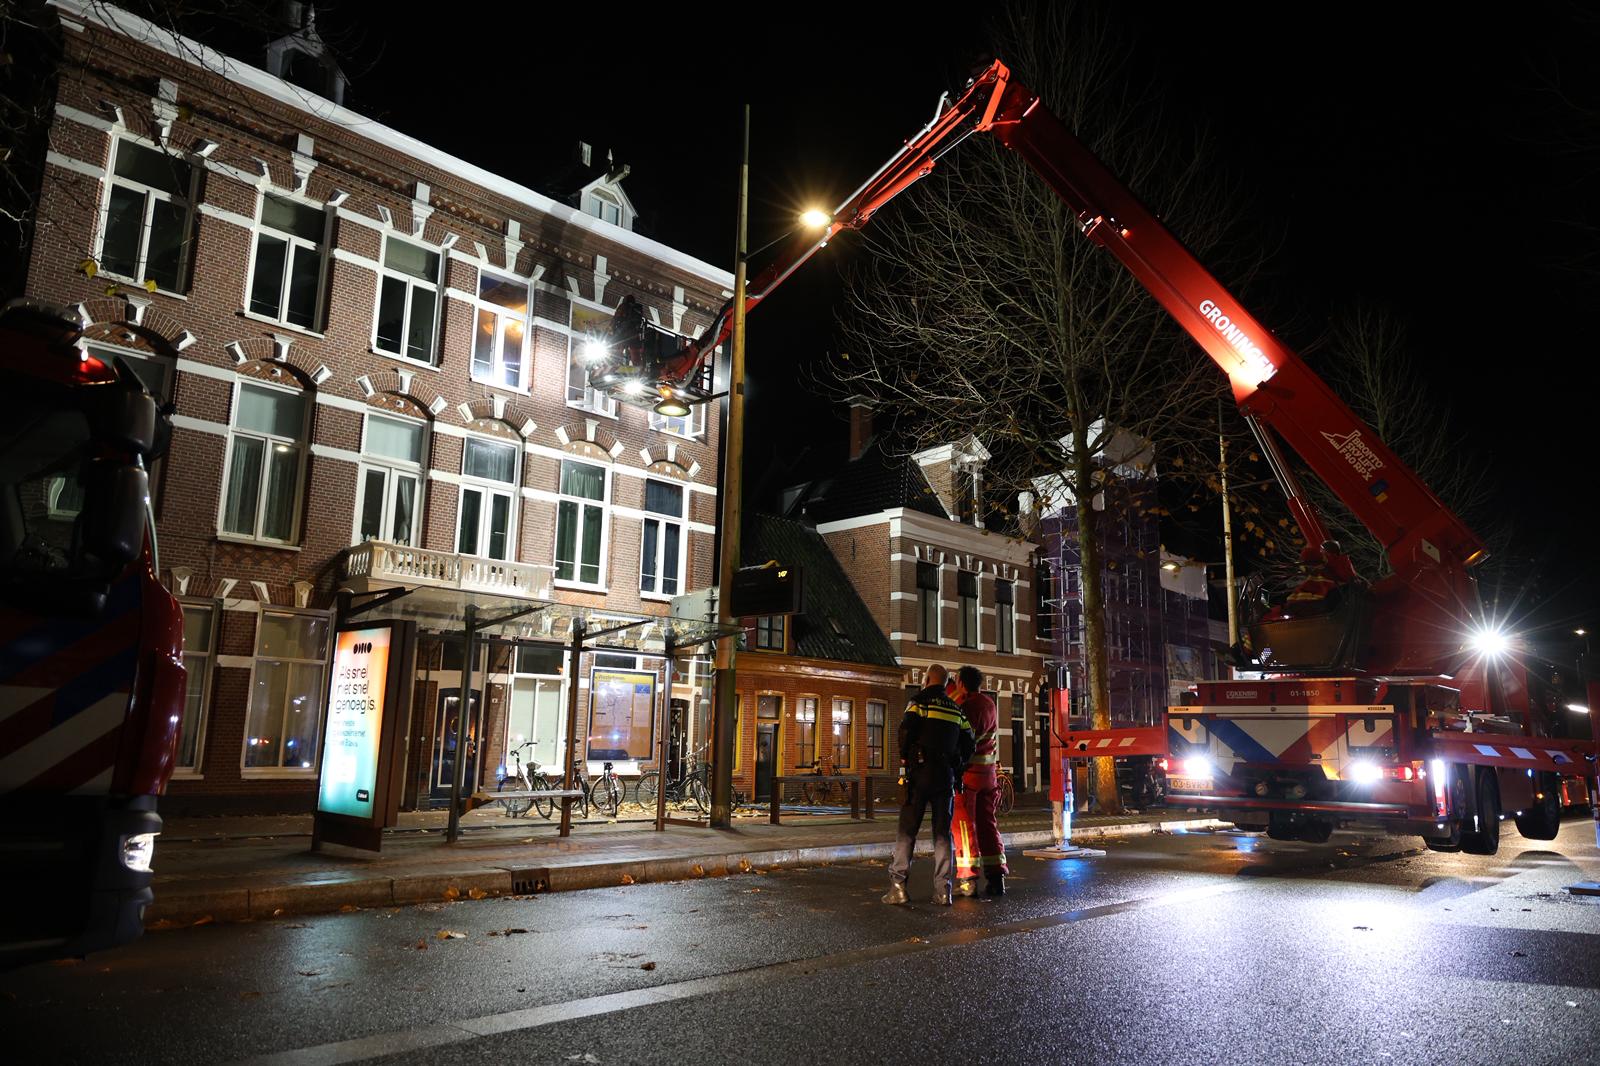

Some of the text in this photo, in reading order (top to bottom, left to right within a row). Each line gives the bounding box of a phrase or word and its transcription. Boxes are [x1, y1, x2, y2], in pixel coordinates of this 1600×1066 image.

[1200, 299, 1278, 382] GRONINGEN
[1346, 442, 1376, 472] SKYLIFT
[1352, 437, 1384, 468] BRONTO
[1353, 462, 1373, 481] RPX
[352, 664, 368, 679] snel
[353, 680, 369, 695] snel
[336, 699, 366, 714] genoeg
